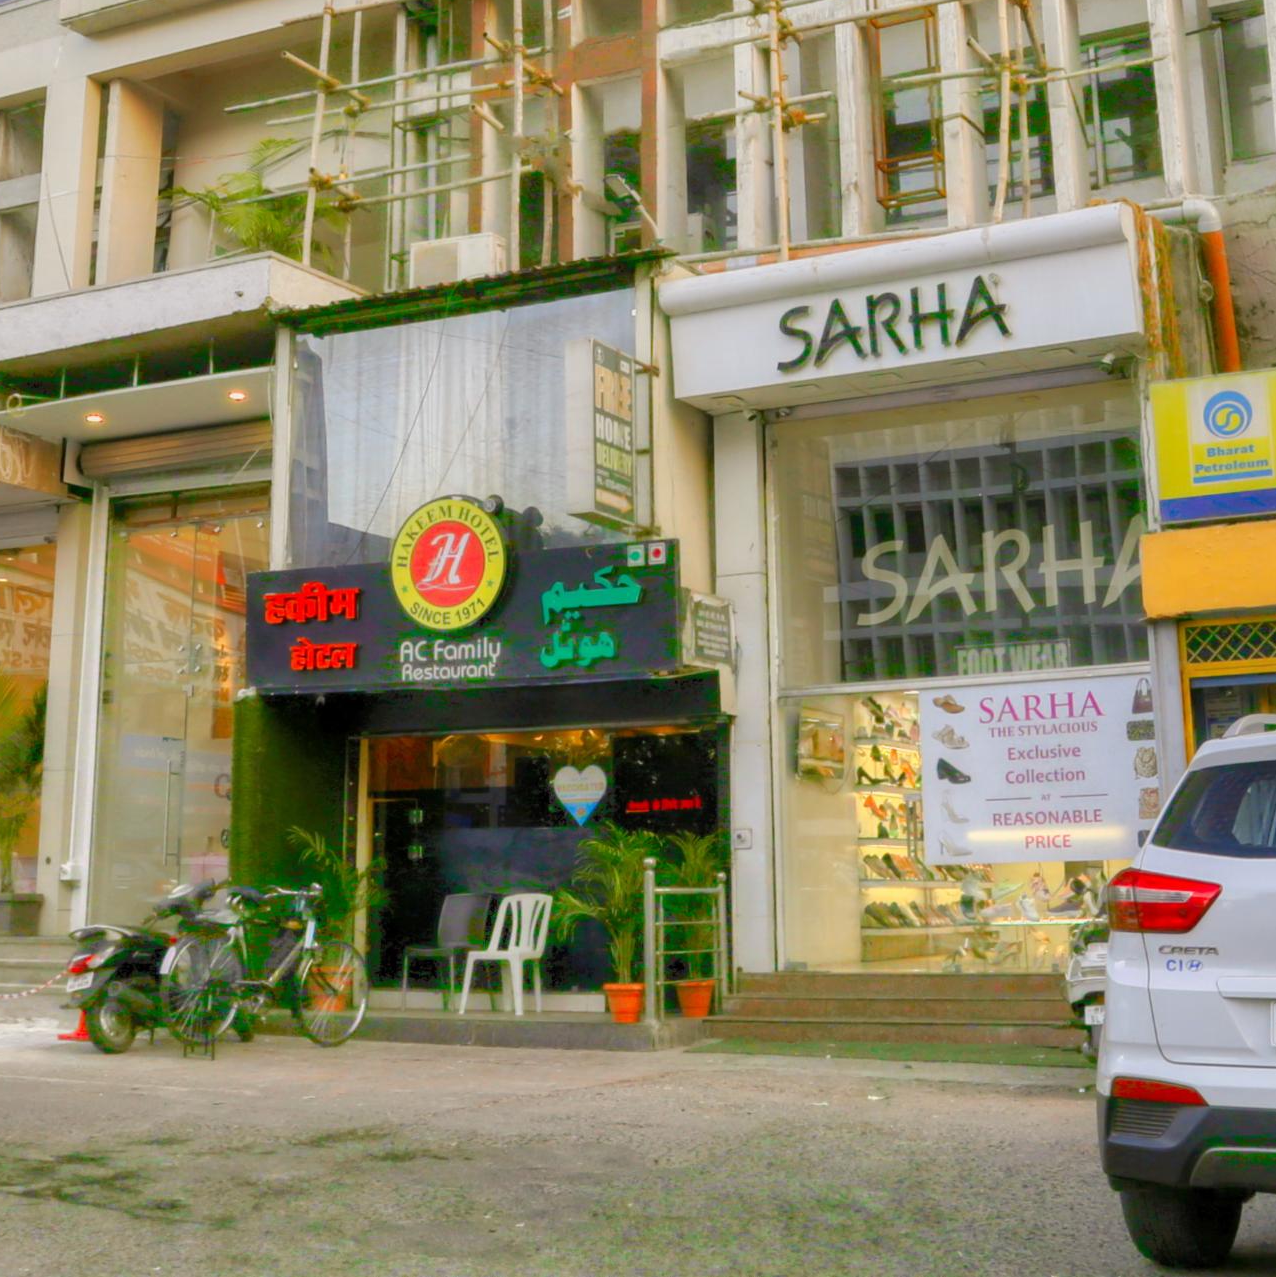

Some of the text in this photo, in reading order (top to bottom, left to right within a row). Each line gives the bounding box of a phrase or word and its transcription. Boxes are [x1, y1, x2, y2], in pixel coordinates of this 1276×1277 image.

[777, 274, 1013, 373] SARHA
[595, 412, 632, 451] HOME
[1206, 443, 1255, 459] Bharat
[1195, 456, 1270, 476] Petroleum
[396, 505, 500, 568] HAKEEM HOTEL
[263, 581, 361, 624] हकीम
[409, 597, 486, 625] SINCE 1971
[290, 636, 358, 671] होटल
[400, 636, 501, 663] AC Family
[402, 661, 496, 683] Restaurant
[979, 690, 1106, 724] SARHA
[988, 721, 1098, 738] THE STYLACIOUS
[1007, 744, 1081, 761] Exclusive
[1005, 767, 1085, 785] Collection
[1040, 793, 1052, 802] AT
[992, 808, 1102, 827] REASONABLE
[1025, 834, 1072, 850] PRICE
[1158, 944, 1219, 956] CRETA
